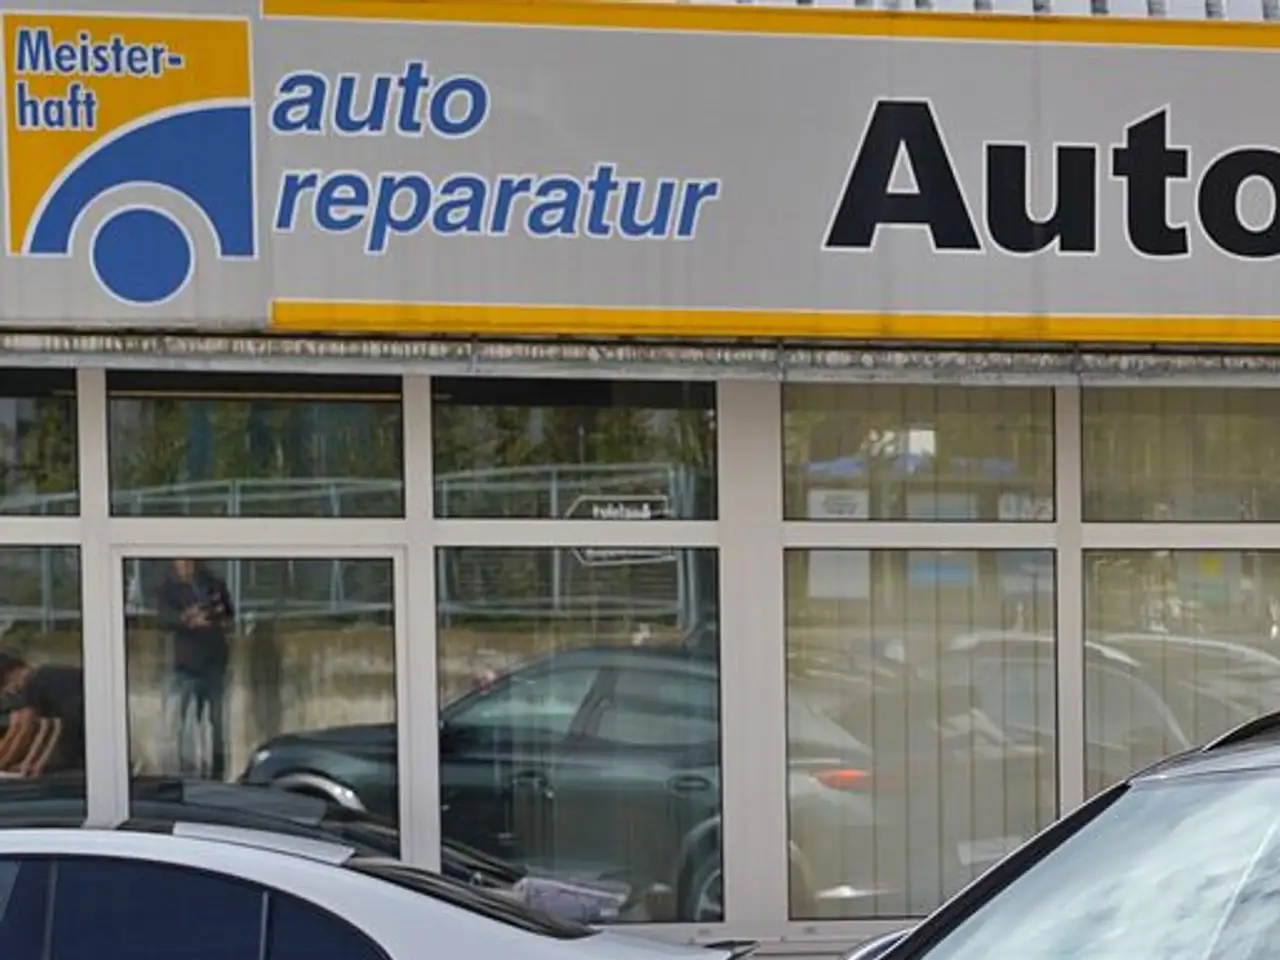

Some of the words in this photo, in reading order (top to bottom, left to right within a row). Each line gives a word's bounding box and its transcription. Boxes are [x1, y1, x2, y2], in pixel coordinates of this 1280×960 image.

[15, 29, 184, 76] Meister-
[16, 83, 97, 130] haft
[272, 62, 488, 136] auto
[276, 165, 719, 253] reparatur
